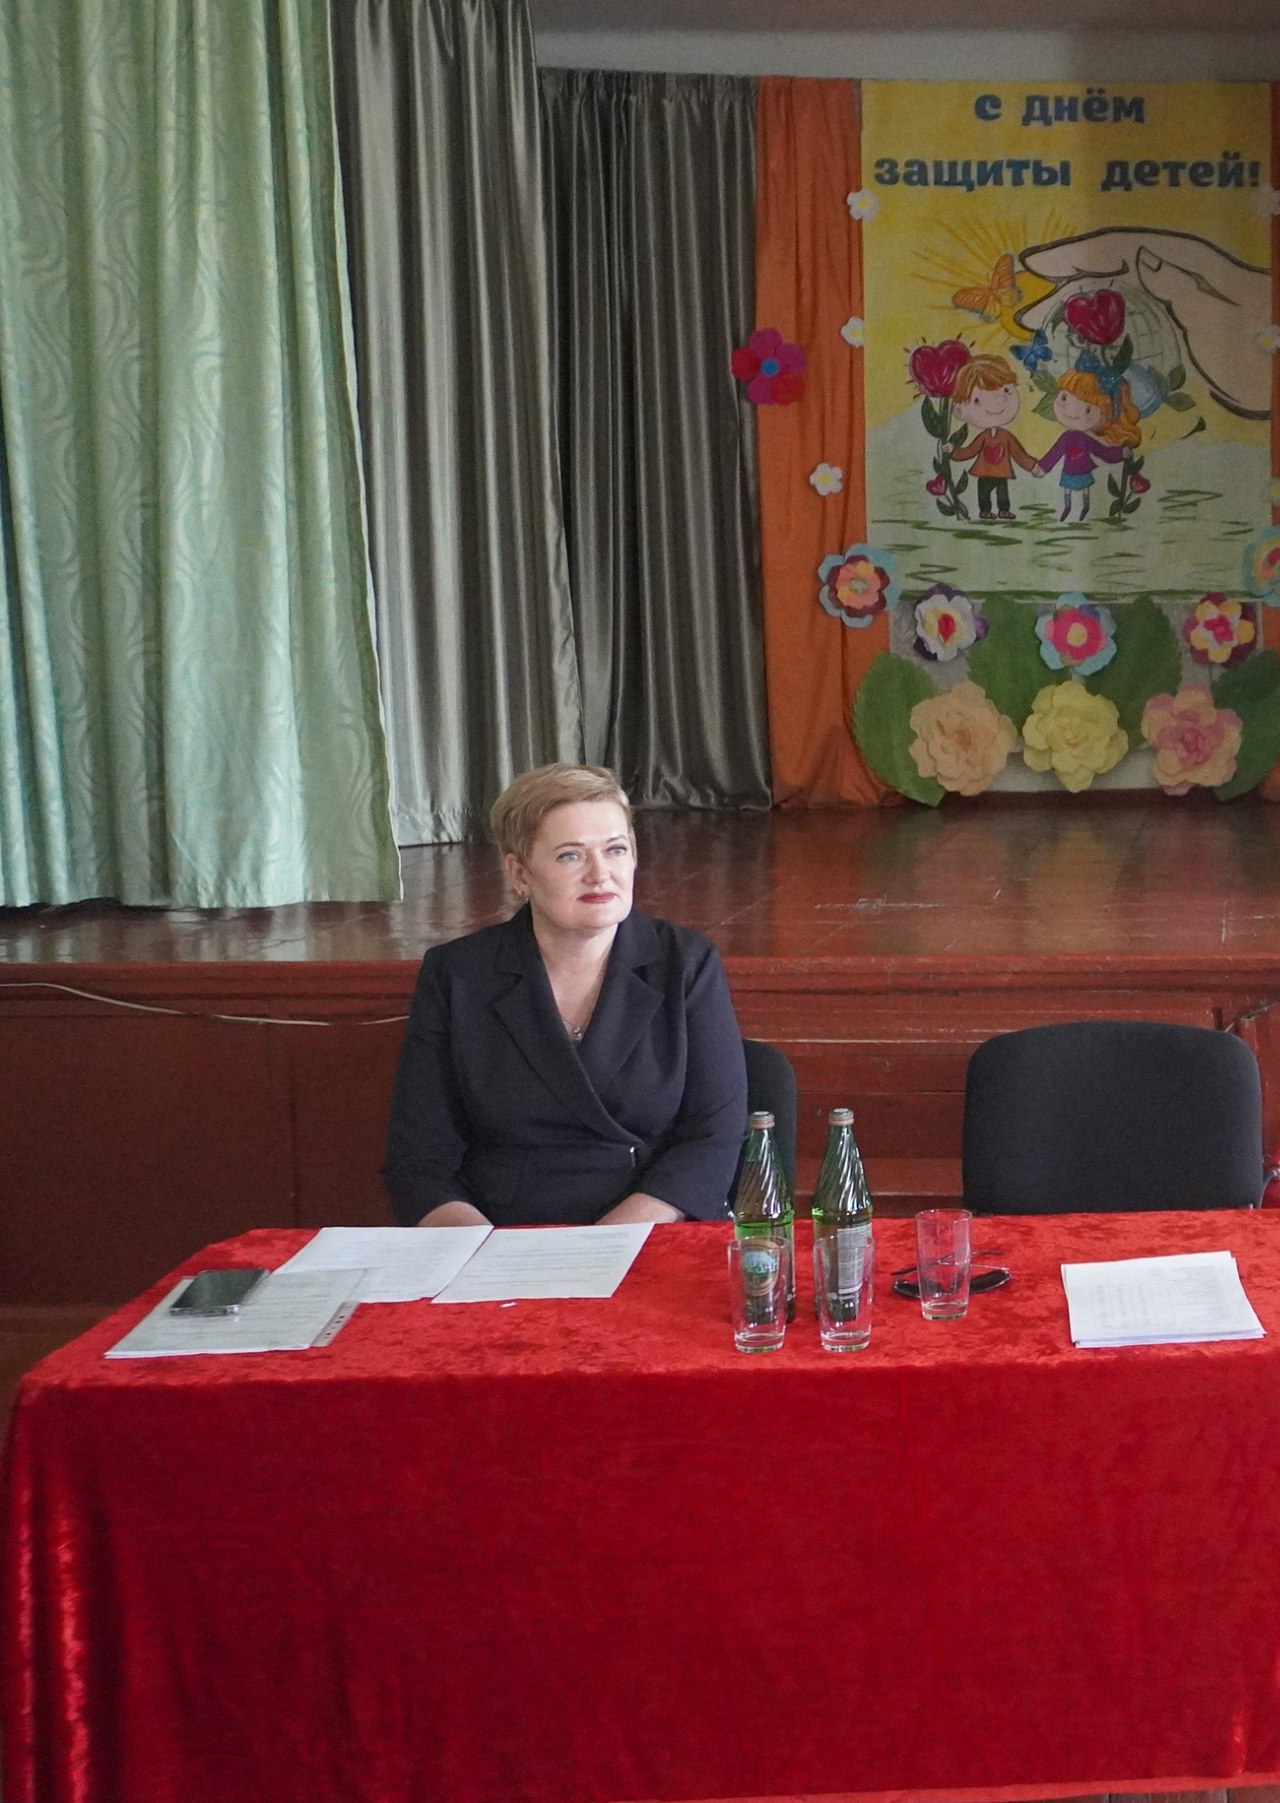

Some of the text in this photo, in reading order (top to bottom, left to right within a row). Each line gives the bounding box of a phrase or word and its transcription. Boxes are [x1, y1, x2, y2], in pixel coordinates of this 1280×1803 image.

[1021, 88, 1146, 126] днём
[874, 151, 1261, 192] защиты детей!
